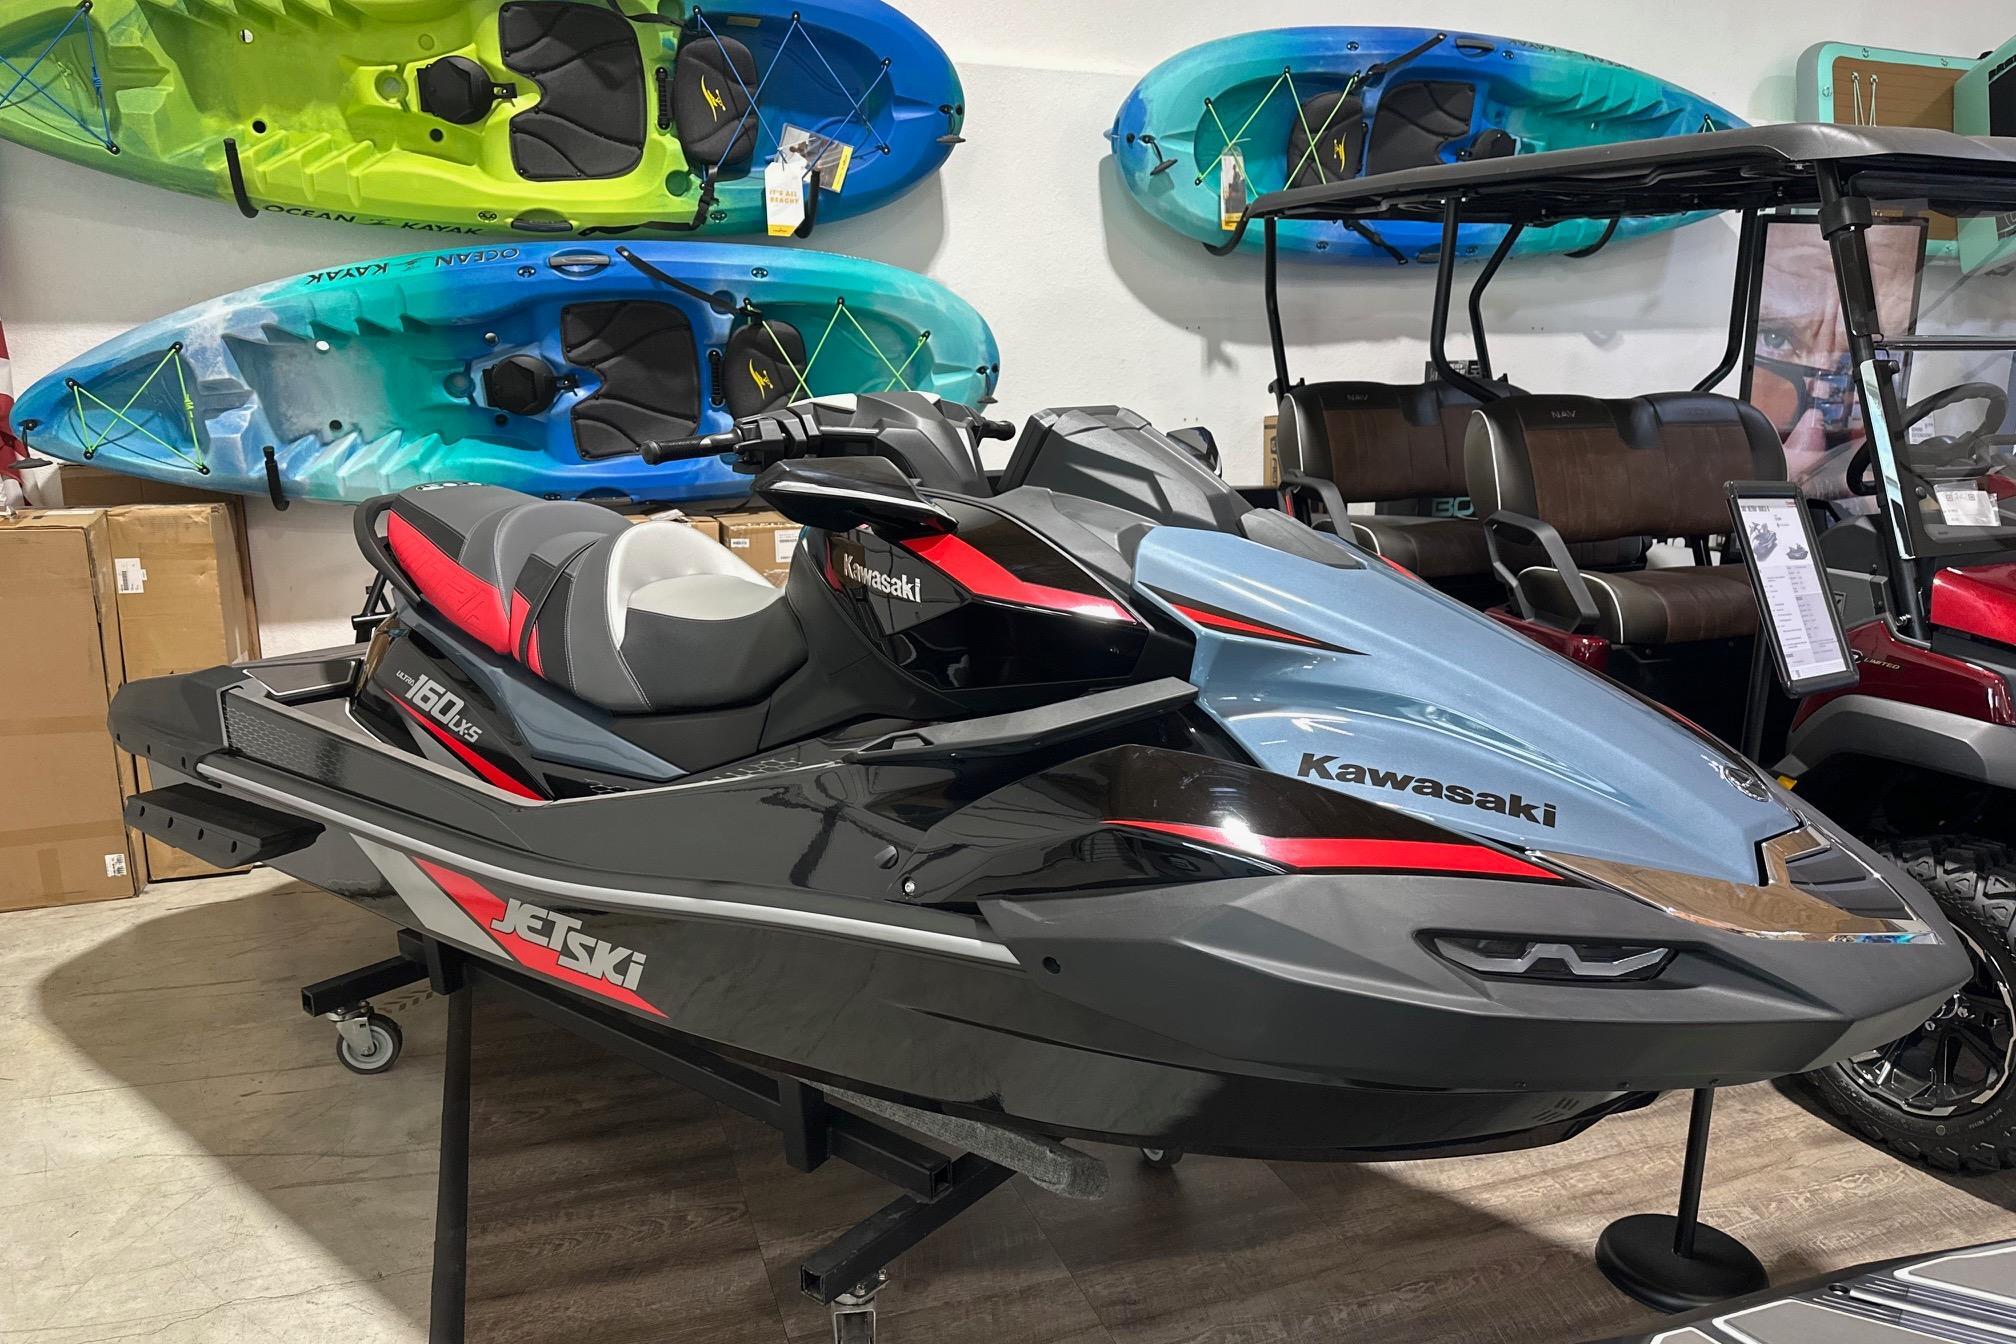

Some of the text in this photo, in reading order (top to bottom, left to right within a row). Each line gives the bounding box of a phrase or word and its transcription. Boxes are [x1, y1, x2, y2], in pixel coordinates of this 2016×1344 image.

[264, 204, 484, 235] OCEAN KAYAK
[305, 248, 520, 285] OCEAN KAYAK
[1551, 410, 1576, 418] NAV
[843, 553, 921, 603] Kawasaki
[395, 670, 415, 686] ULTRA
[1863, 657, 1901, 670] LIMITED
[1297, 753, 1556, 828] Kawasaki
